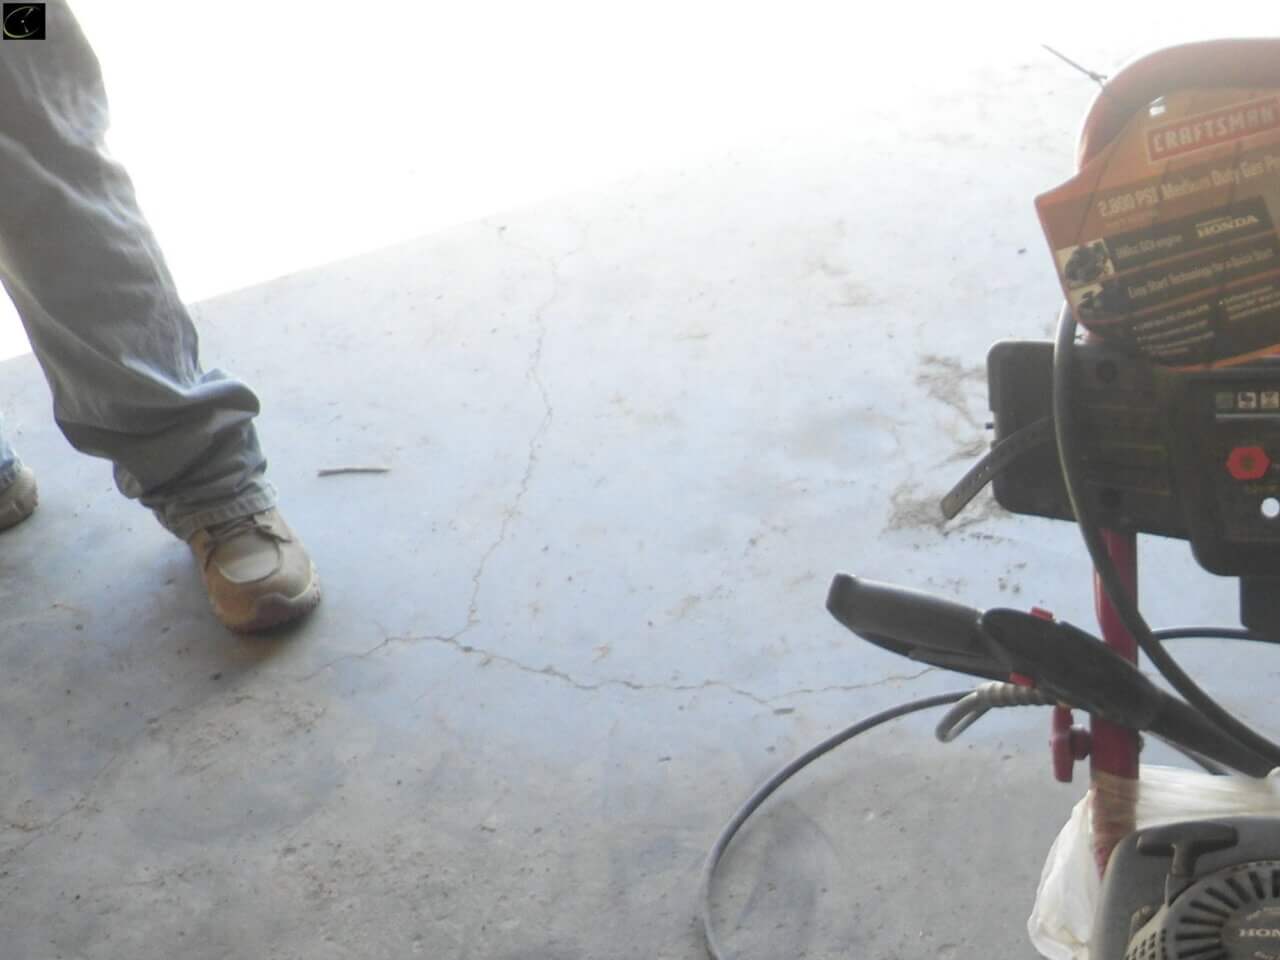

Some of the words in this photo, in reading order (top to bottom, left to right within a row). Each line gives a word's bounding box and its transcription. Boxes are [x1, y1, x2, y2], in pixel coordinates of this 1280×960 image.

[1153, 105, 1275, 152] CRAFTSMAN
[1135, 186, 1159, 207] PSI
[1161, 176, 1211, 201] Medium
[1212, 166, 1241, 187] Duty
[1240, 159, 1265, 180] Gas
[1197, 215, 1259, 238] HONDA
